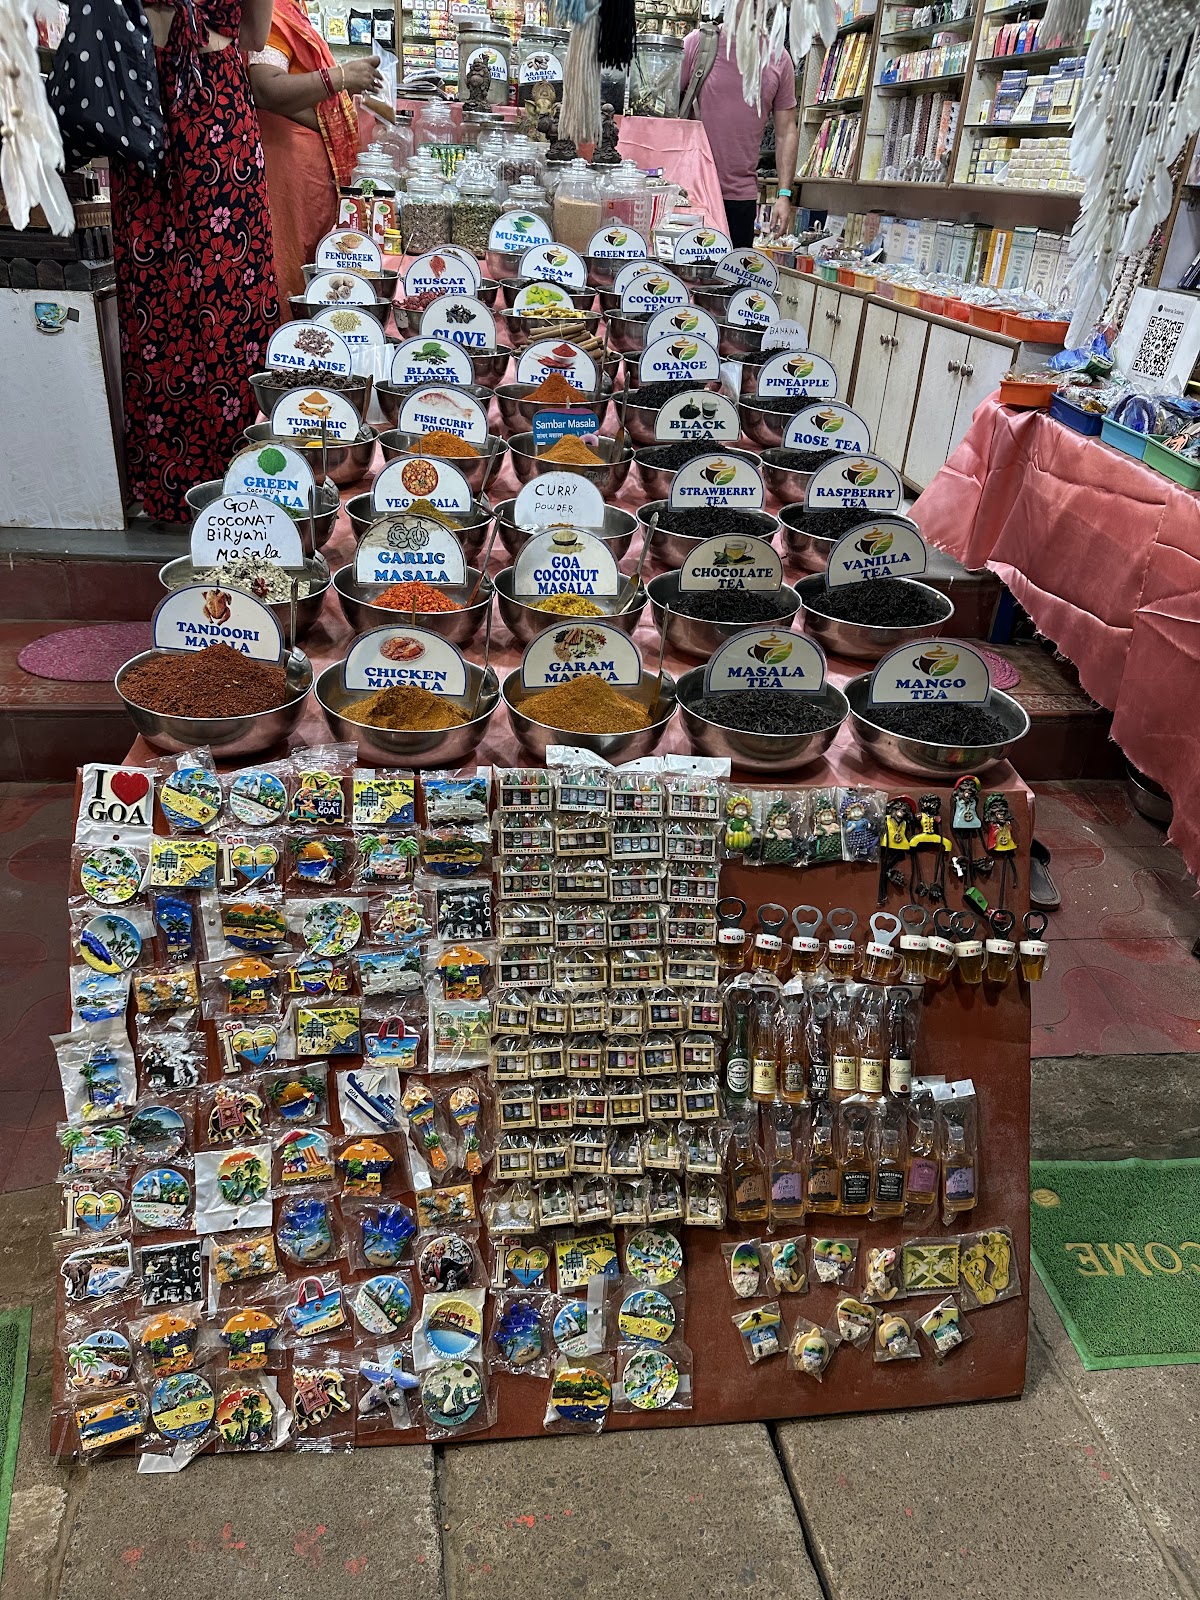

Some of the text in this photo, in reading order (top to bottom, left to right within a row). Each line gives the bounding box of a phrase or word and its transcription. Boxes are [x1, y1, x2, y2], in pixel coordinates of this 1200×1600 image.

[496, 231, 549, 244] MUSTARD
[325, 252, 373, 262] FENUGREEK
[534, 265, 573, 278] ASSAM
[722, 263, 773, 288] DARJEELING
[413, 277, 466, 285] MUSCAT
[541, 272, 564, 282] TEA
[737, 277, 751, 287] TEA
[415, 286, 467, 294] FLOWER
[644, 304, 665, 312] TEA
[738, 309, 770, 323] GINGER
[769, 327, 798, 335] BANANA
[433, 329, 486, 347] CLOVE
[273, 353, 346, 372] STAR ANISE
[653, 361, 707, 371] ORANGE
[407, 367, 456, 375] BLACK
[667, 371, 693, 379] TEA
[404, 375, 460, 383] PEPPER
[531, 375, 583, 388] POER
[766, 378, 829, 387] PINEAPPLE
[786, 388, 808, 396] TEA
[414, 414, 474, 430] FISH CURRY
[536, 418, 595, 429] Sambar Masala
[670, 421, 726, 429] BLACK
[681, 430, 714, 439] TEA
[794, 433, 861, 452] ROSE TEA
[244, 477, 299, 491] GREEN
[535, 484, 578, 496] CURRY
[679, 487, 756, 496] STRAWBERRY
[816, 488, 895, 498] RASPBERRY
[224, 498, 259, 513] GOA
[386, 499, 459, 507] VEG SALA
[706, 496, 728, 505] TEA
[842, 498, 867, 507] TEA
[378, 553, 445, 564] GARLIC
[552, 557, 580, 568] GOA
[843, 553, 911, 570] VANILLA
[375, 570, 450, 582] MASALA
[534, 570, 598, 582] COCONUT
[692, 567, 774, 578] CHOCOLATE
[861, 567, 892, 579] TEA
[538, 582, 594, 594] MASALA
[718, 579, 744, 589] TEA
[176, 622, 259, 641] TANDOORI
[549, 661, 614, 672] GARAM
[365, 667, 447, 681] CHICKEN
[727, 667, 805, 677] MASALA
[747, 677, 783, 688] TEA
[896, 679, 966, 688] MANGO
[911, 690, 947, 699] TEA
[92, 769, 108, 799] I
[88, 801, 148, 826] GOA
[318, 806, 339, 815] GOA!
[226, 836, 244, 844] Goa
[816, 1067, 828, 1075] VAT
[348, 1089, 358, 1099] GOA
[504, 1238, 520, 1246] Goa
